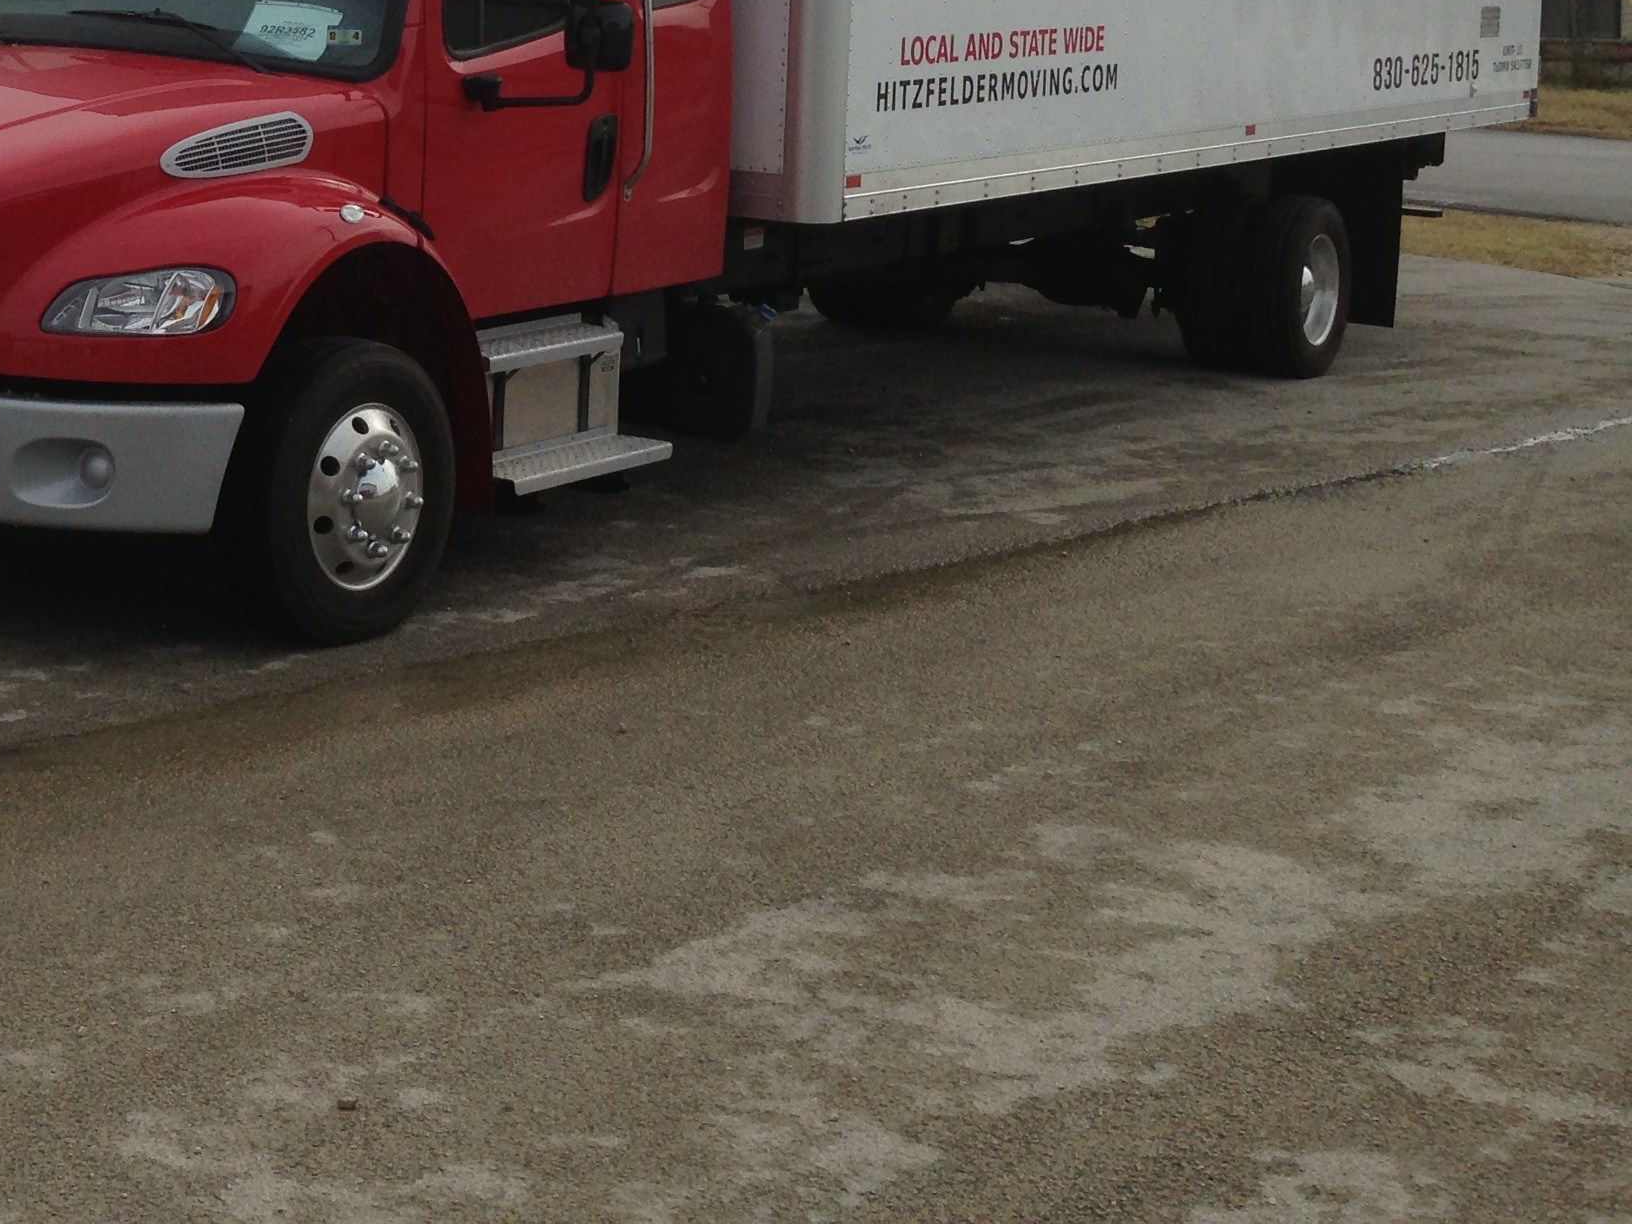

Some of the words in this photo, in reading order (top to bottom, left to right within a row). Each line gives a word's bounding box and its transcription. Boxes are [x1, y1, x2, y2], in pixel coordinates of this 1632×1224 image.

[900, 33, 960, 67] LOCAL
[964, 31, 1004, 63] AND
[1008, 27, 1058, 60] STATE
[1062, 24, 1106, 55] WIDE
[876, 63, 1119, 113] HITZFELDERMOVING.COM
[1372, 49, 1480, 92] 830-625-1815
